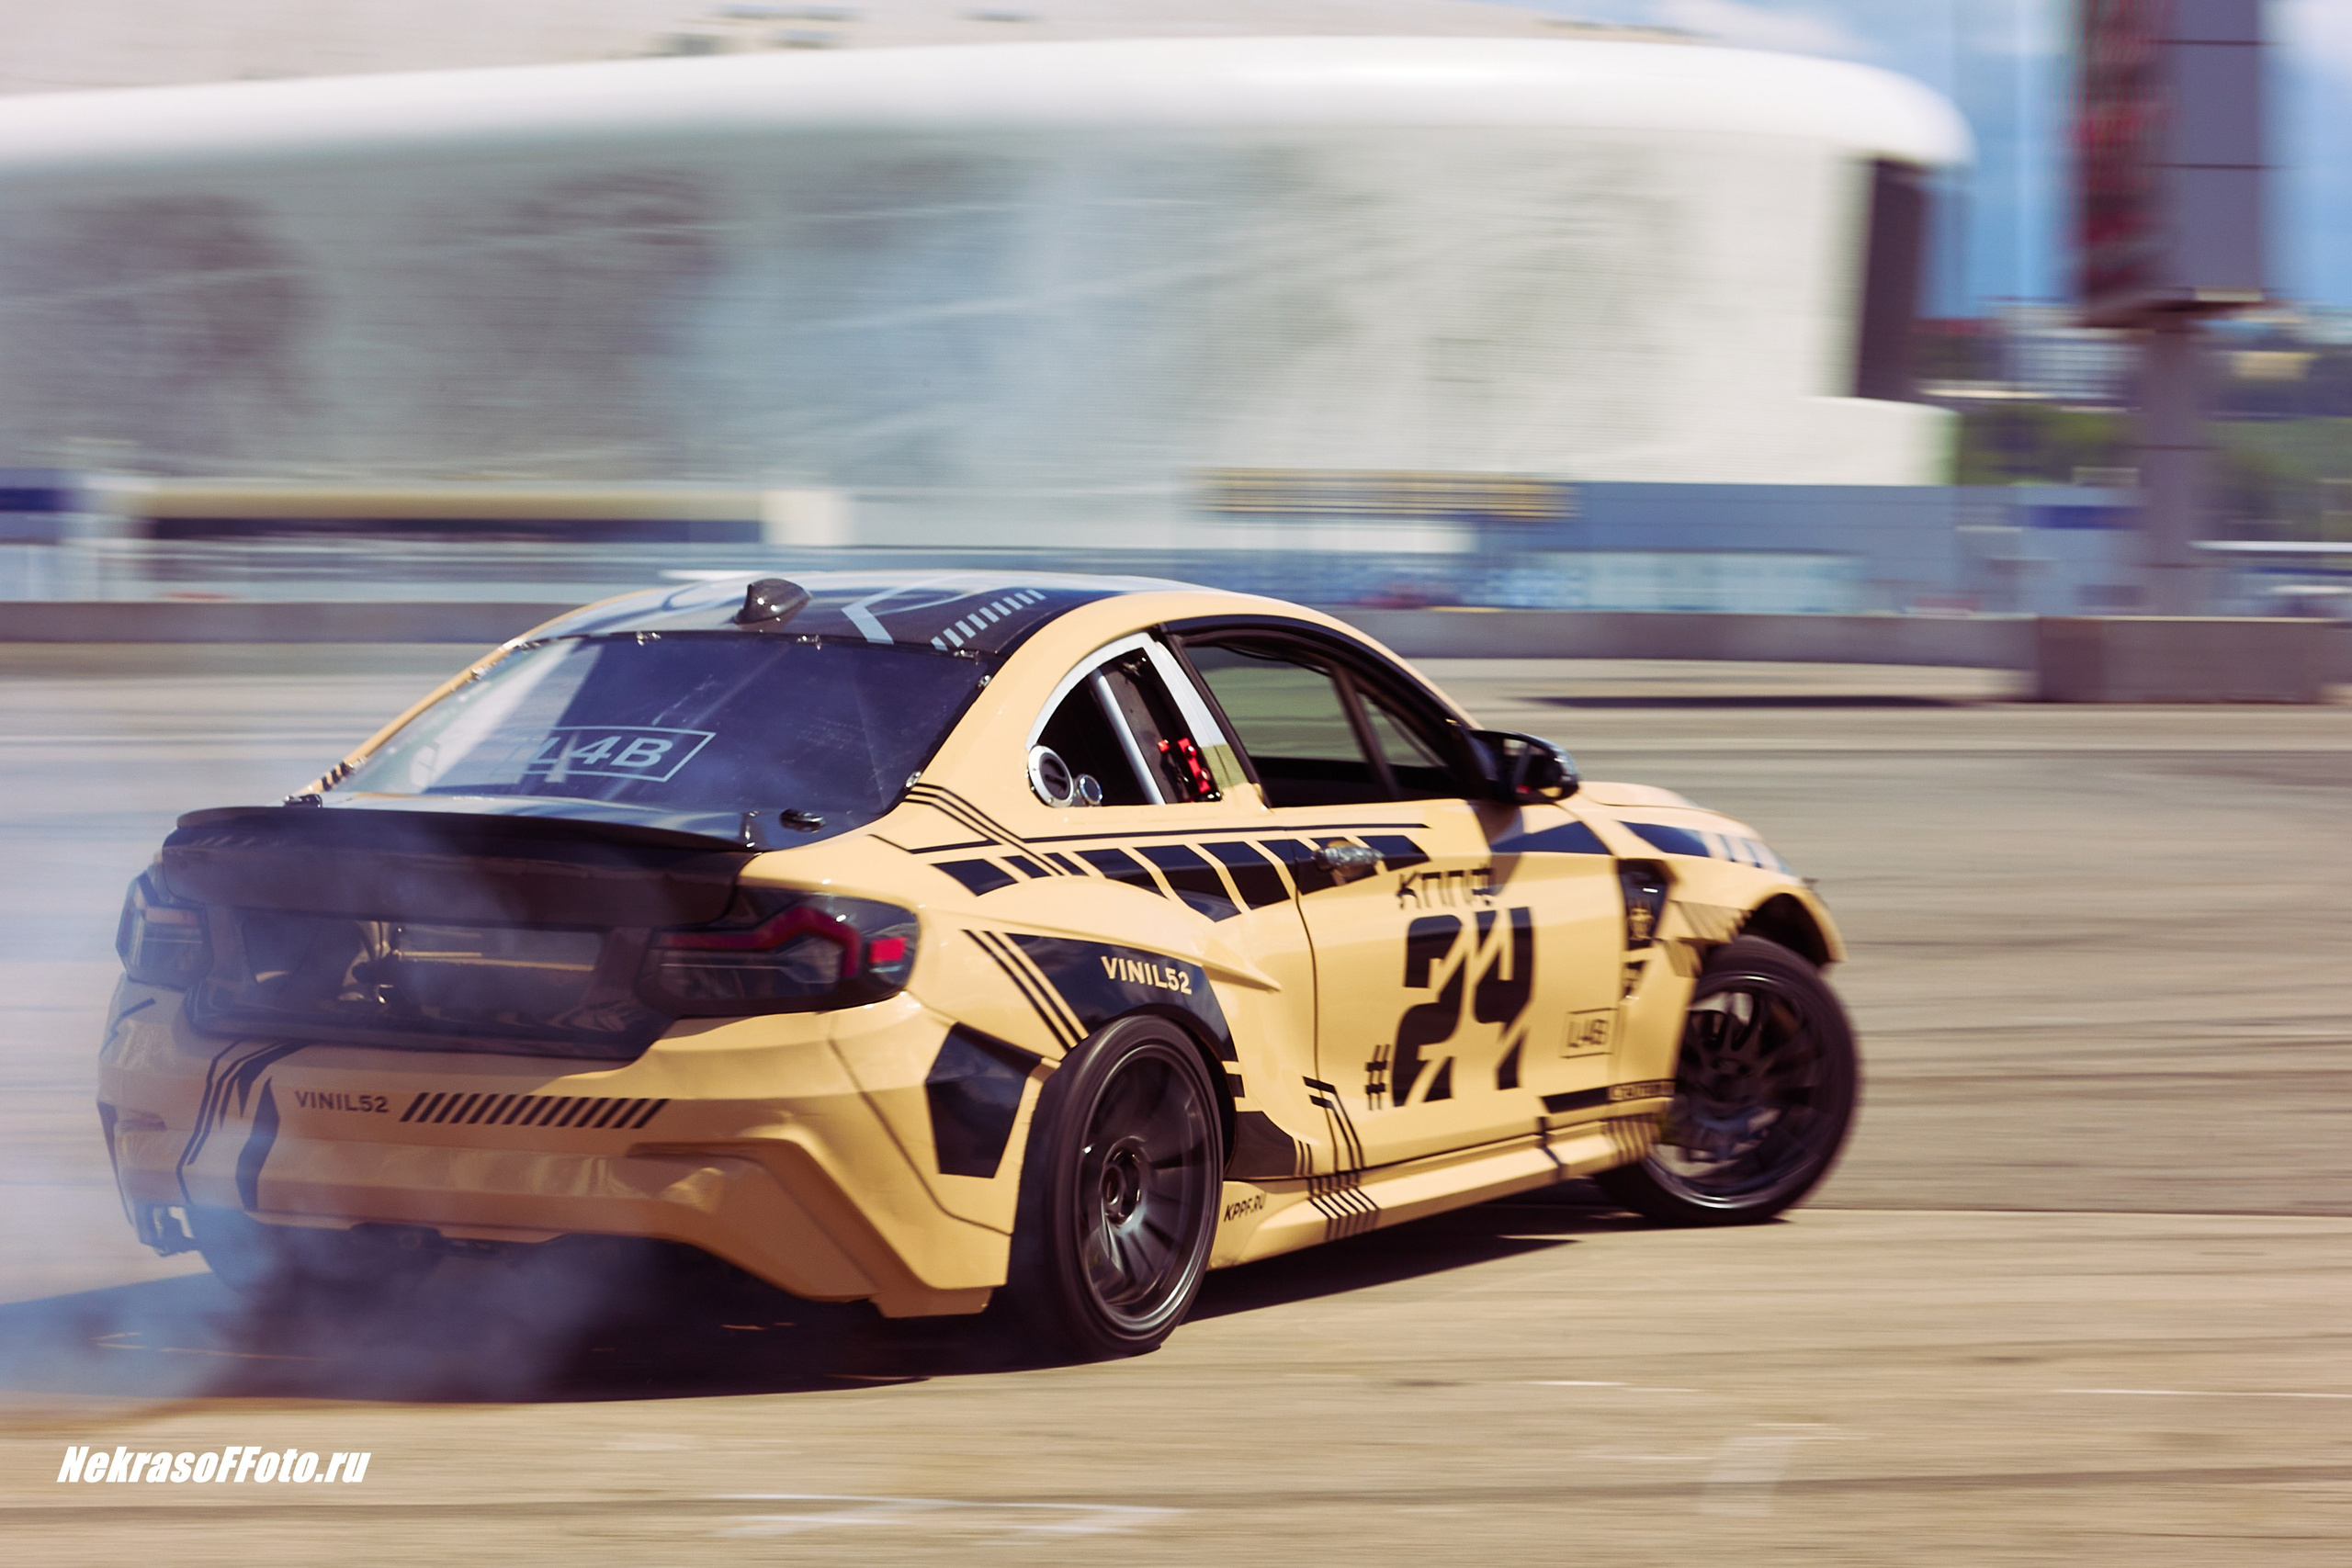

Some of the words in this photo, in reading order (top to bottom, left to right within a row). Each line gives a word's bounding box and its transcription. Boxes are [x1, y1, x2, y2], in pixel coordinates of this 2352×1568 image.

[528, 736, 673, 768] L4B
[1101, 955, 1193, 996] VINIL52
[294, 1090, 389, 1113] VINIL52
